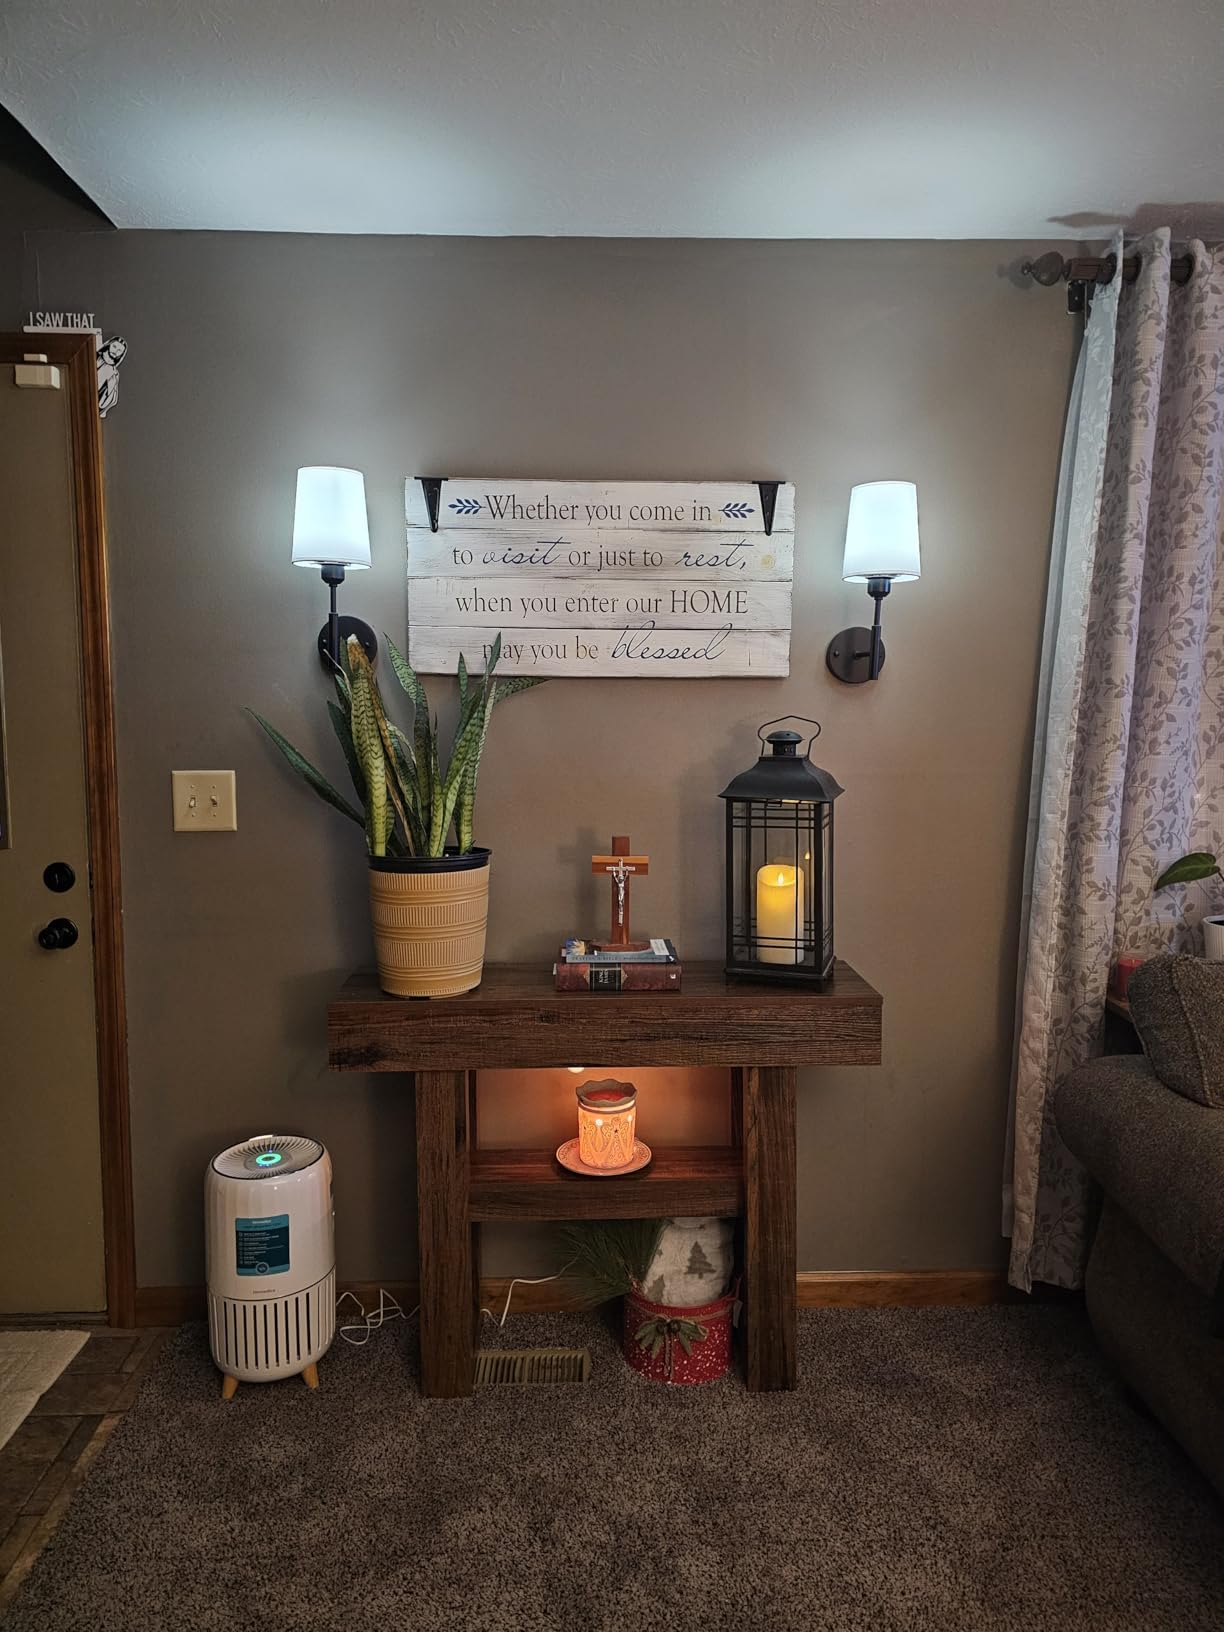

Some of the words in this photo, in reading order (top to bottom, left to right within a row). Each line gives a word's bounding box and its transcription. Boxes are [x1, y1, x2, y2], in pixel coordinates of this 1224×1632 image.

[29, 311, 34, 327] I
[36, 312, 64, 328] SAW
[65, 313, 95, 329] THAT
[484, 494, 579, 520] Whether
[585, 504, 622, 526] you
[629, 504, 685, 521] come
[693, 499, 712, 521] in
[453, 547, 473, 565] to
[482, 536, 571, 565] visit
[568, 550, 591, 566] or
[597, 544, 636, 572] just
[643, 550, 663, 567] to
[675, 539, 754, 570] rest,
[456, 587, 513, 613] when
[520, 597, 557, 618] you
[565, 595, 619, 613] enter
[626, 597, 662, 613] our
[671, 589, 748, 614] HOME
[530, 644, 567, 664] you
[576, 635, 599, 659] be
[611, 620, 733, 660] blessed
